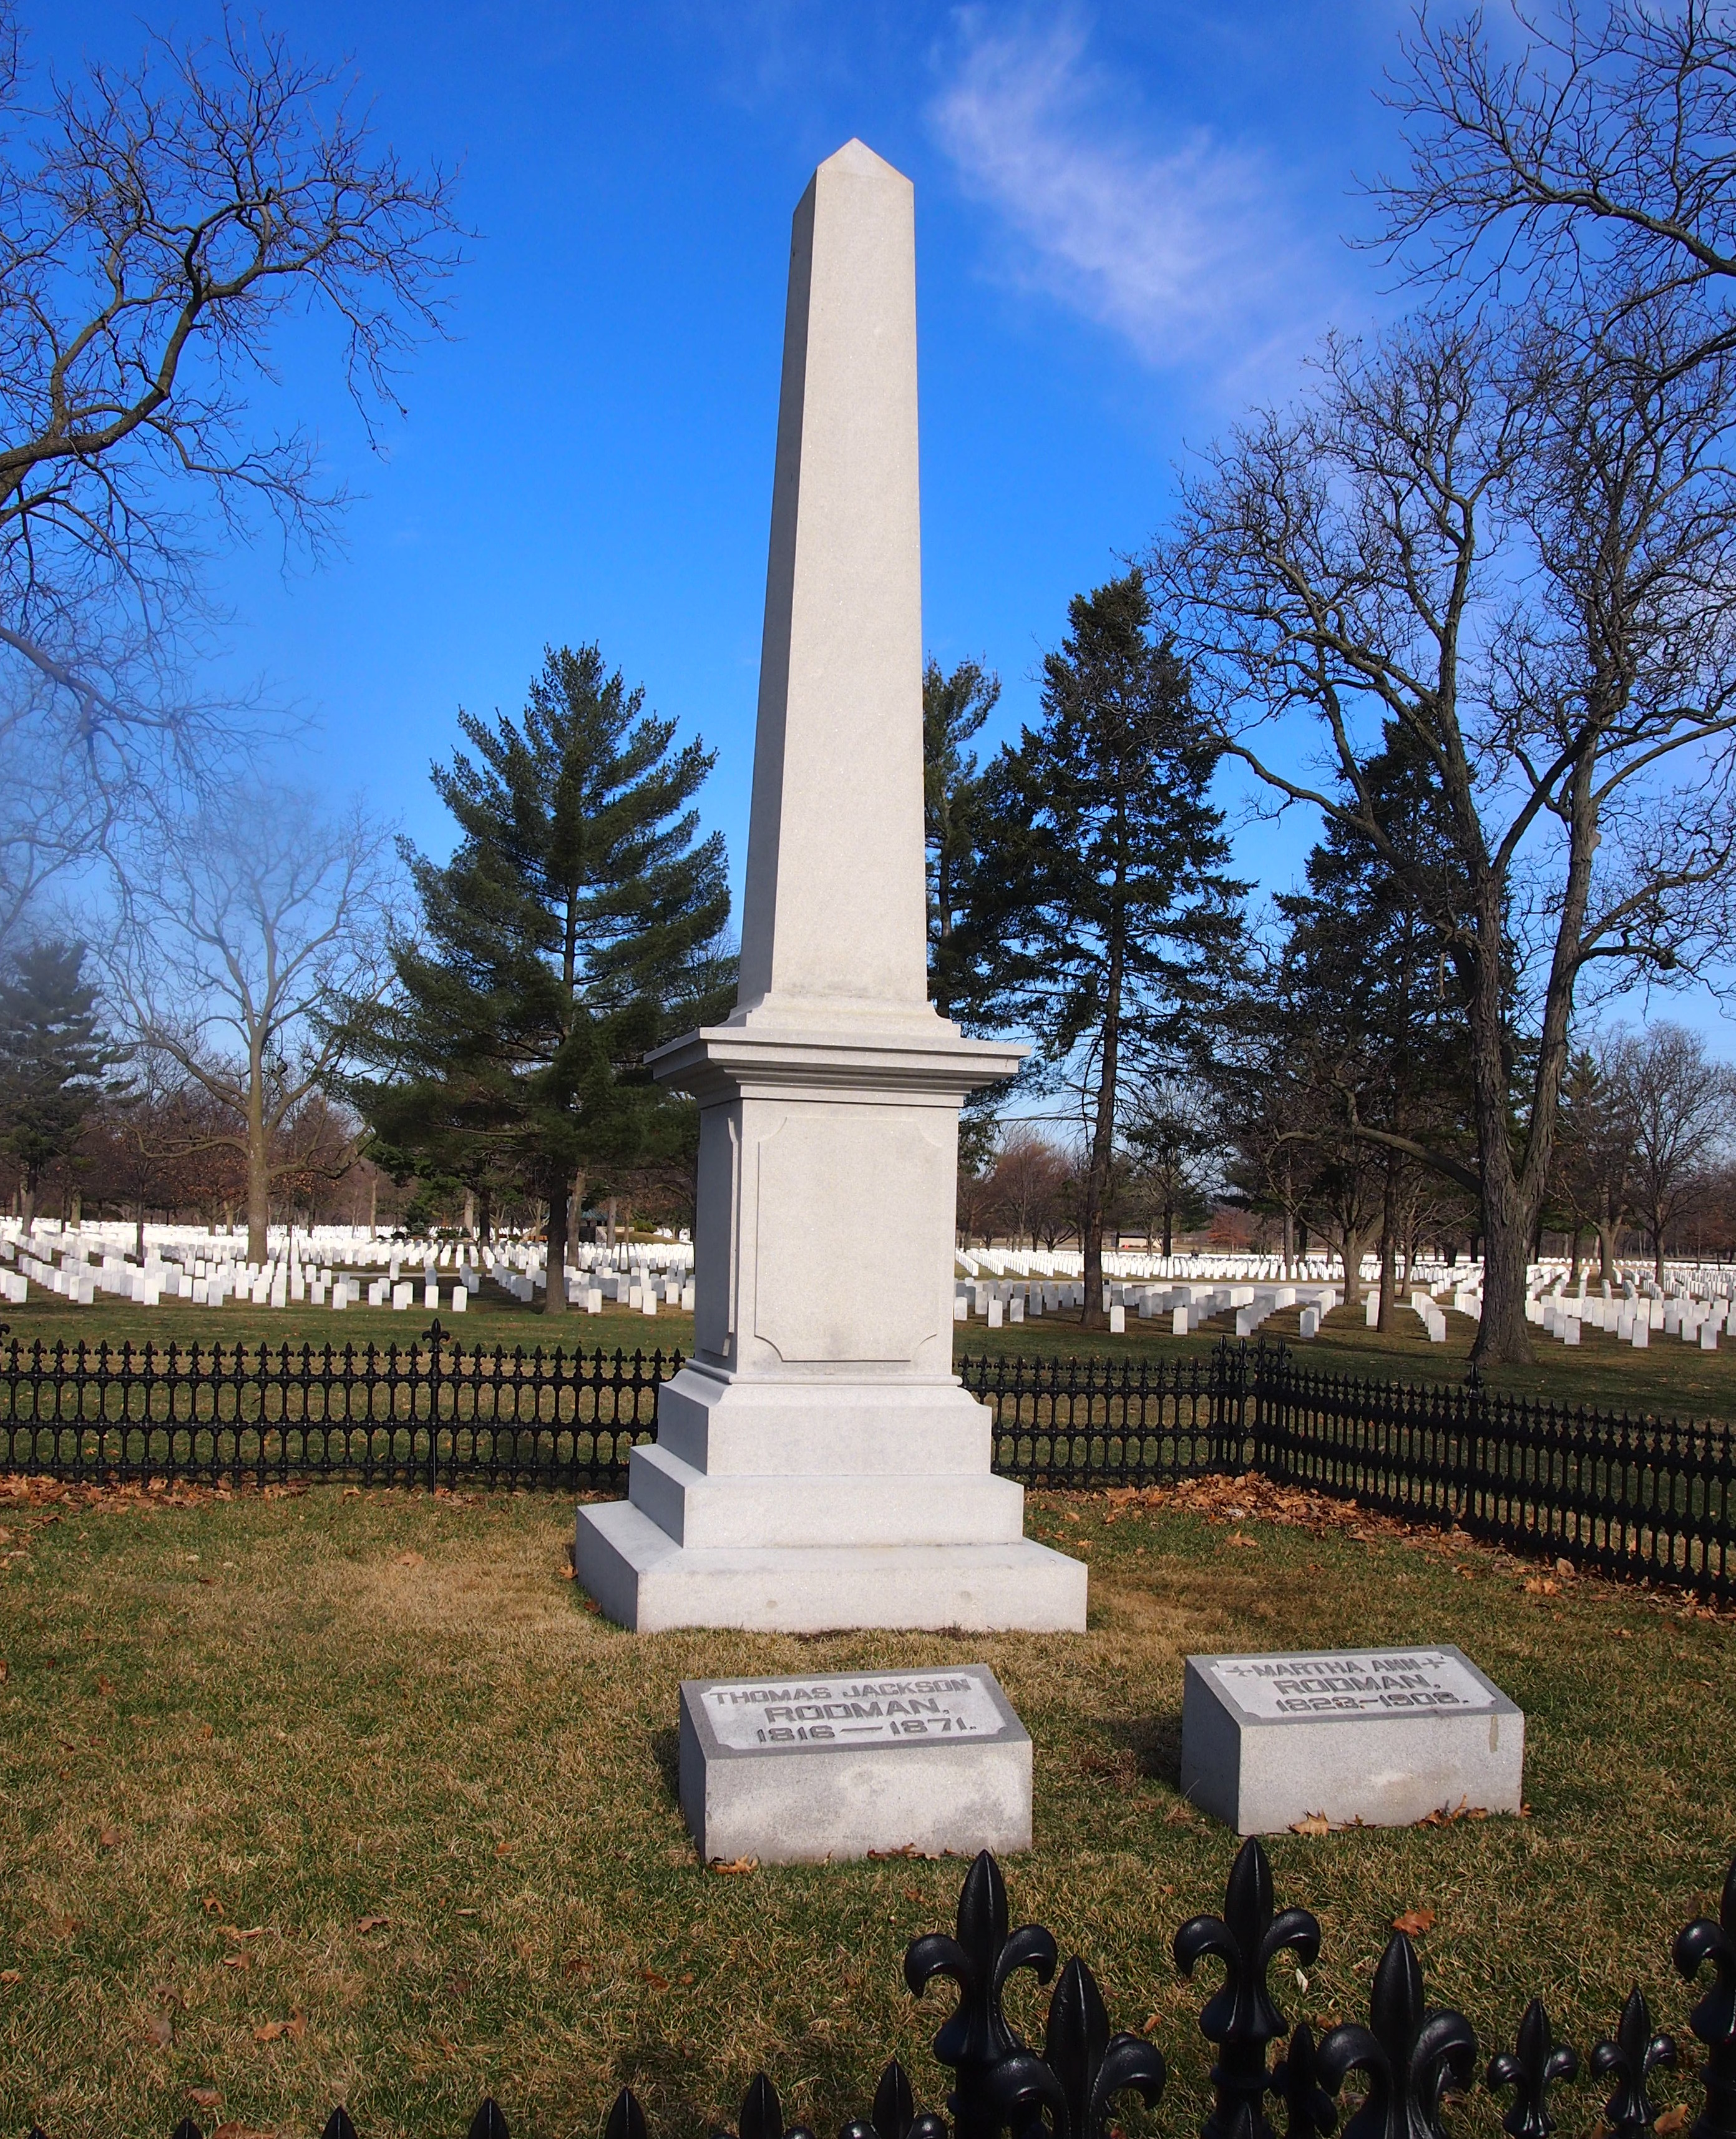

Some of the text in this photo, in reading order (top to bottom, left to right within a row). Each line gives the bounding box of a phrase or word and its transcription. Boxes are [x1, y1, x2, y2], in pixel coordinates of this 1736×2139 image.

[1252, 1658, 1423, 1677] MARTHA ANN
[710, 1678, 972, 1705] THOMAS JACKSON
[1273, 1674, 1441, 1695] RODMAN,
[764, 1698, 950, 1723] RODMAN,
